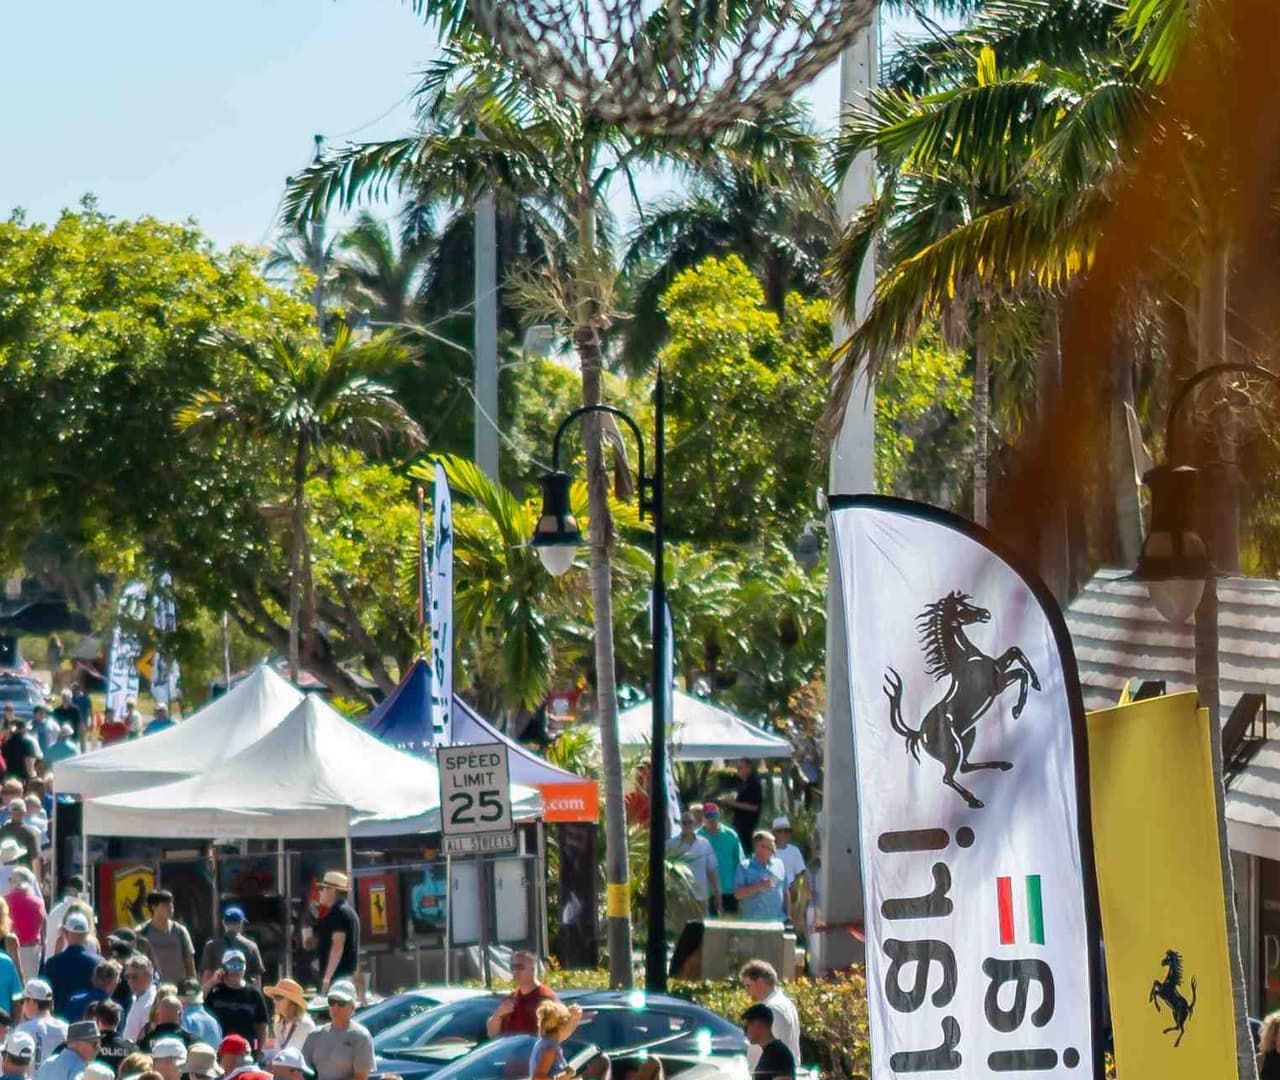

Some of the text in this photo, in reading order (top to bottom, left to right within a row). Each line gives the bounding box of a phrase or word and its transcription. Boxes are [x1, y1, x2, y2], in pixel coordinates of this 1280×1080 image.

[445, 753, 501, 770] SPEED
[453, 772, 496, 788] LIMIT
[449, 790, 504, 825] 25
